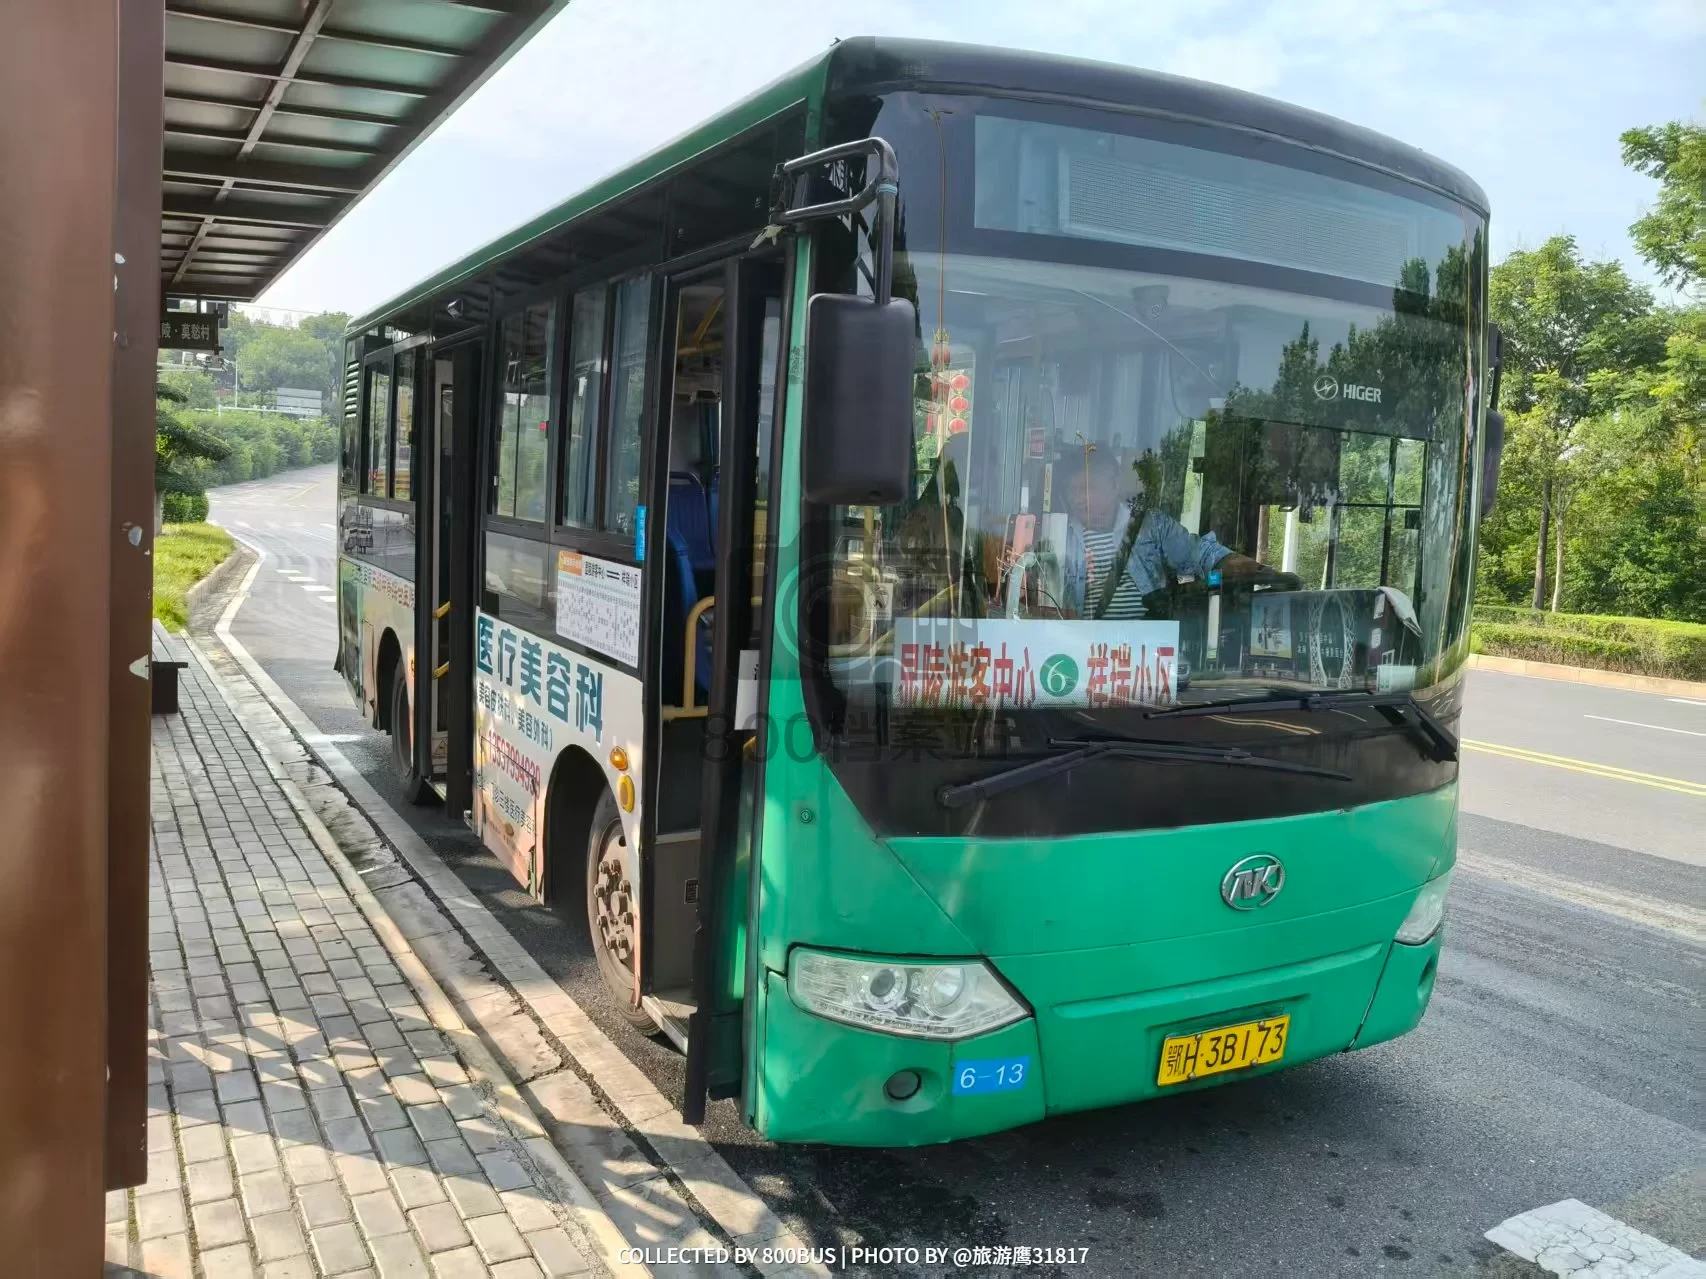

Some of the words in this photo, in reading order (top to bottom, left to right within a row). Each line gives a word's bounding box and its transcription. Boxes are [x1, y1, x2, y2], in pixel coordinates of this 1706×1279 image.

[1344, 383, 1382, 403] HIGER
[477, 614, 604, 745] 医疗美容科
[1086, 642, 1176, 708] 祥瑞小区
[960, 1063, 1024, 1089] 6-13
